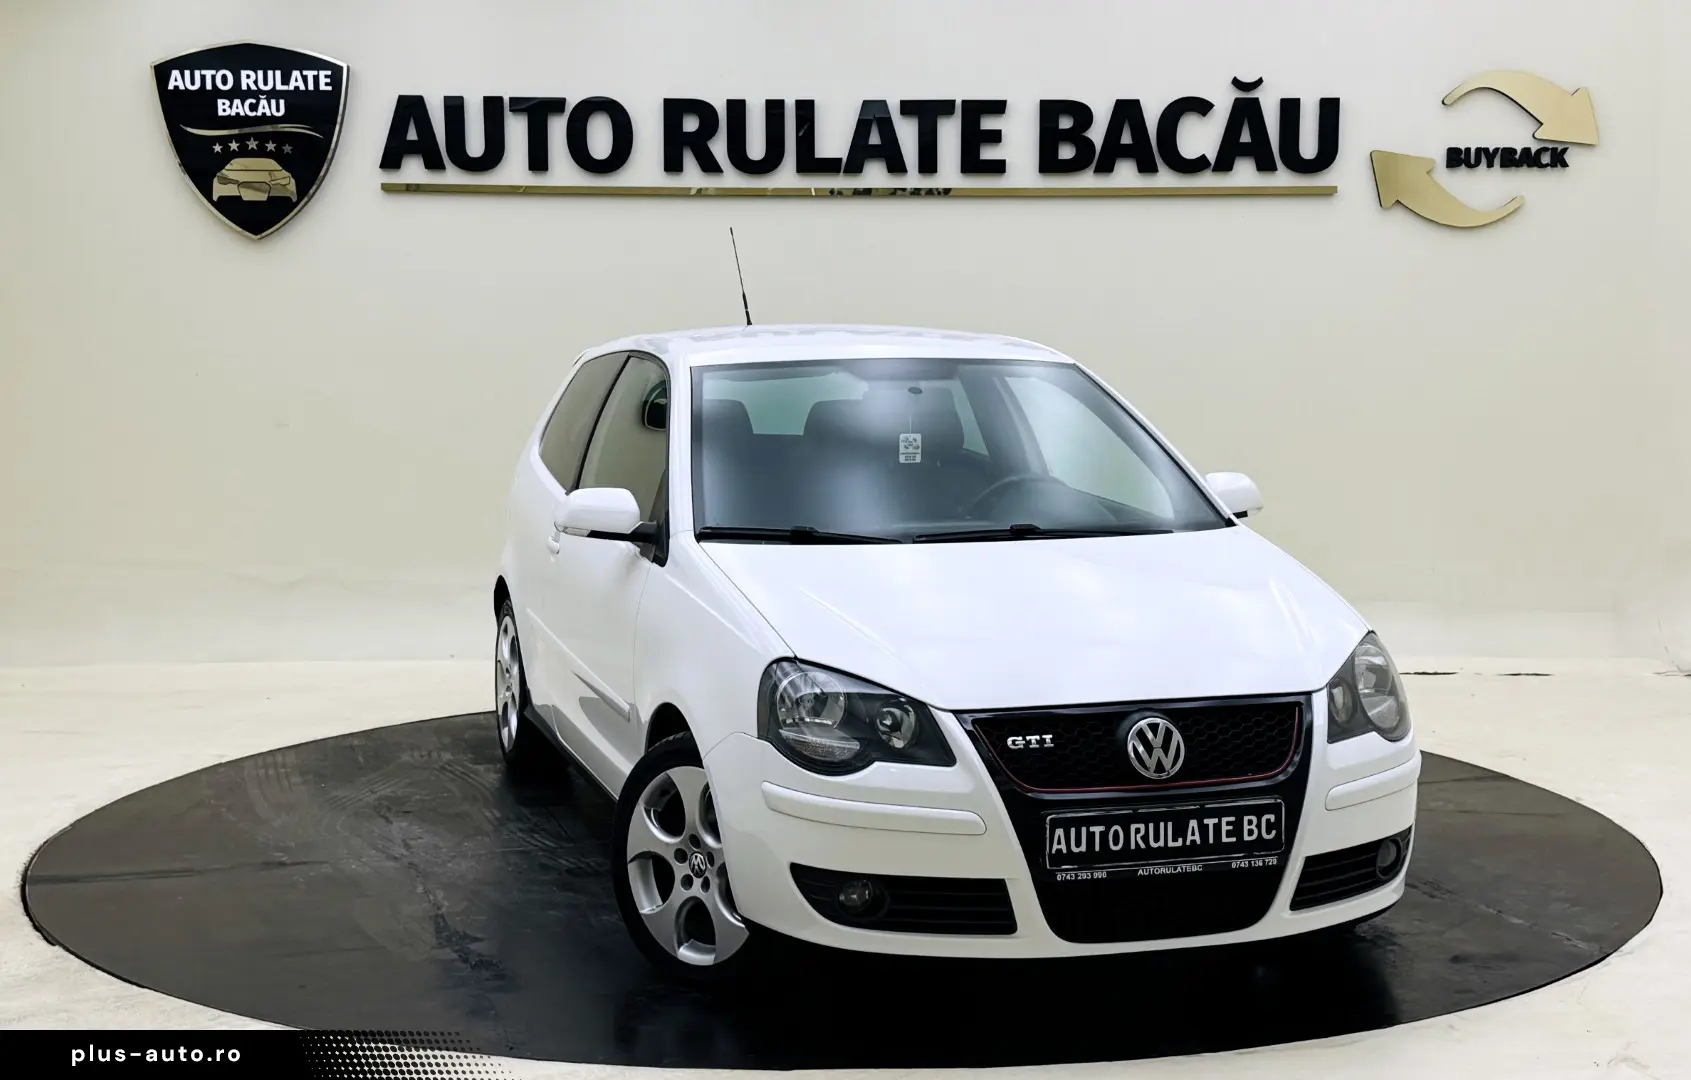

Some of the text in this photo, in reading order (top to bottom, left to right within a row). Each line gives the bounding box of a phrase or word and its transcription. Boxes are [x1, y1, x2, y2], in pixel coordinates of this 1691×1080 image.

[167, 69, 333, 91] AUTO RULATE
[217, 94, 286, 117] BACĂU
[378, 76, 1341, 175] AUTO RULATE BACĂU
[1445, 146, 1570, 169] BUYBACK
[1006, 734, 1055, 750] GTI
[1243, 813, 1277, 841] BC
[1137, 864, 1203, 876] AUTORULATEBC
[1231, 860, 1249, 869] 0743
[1056, 873, 1076, 881] 0743
